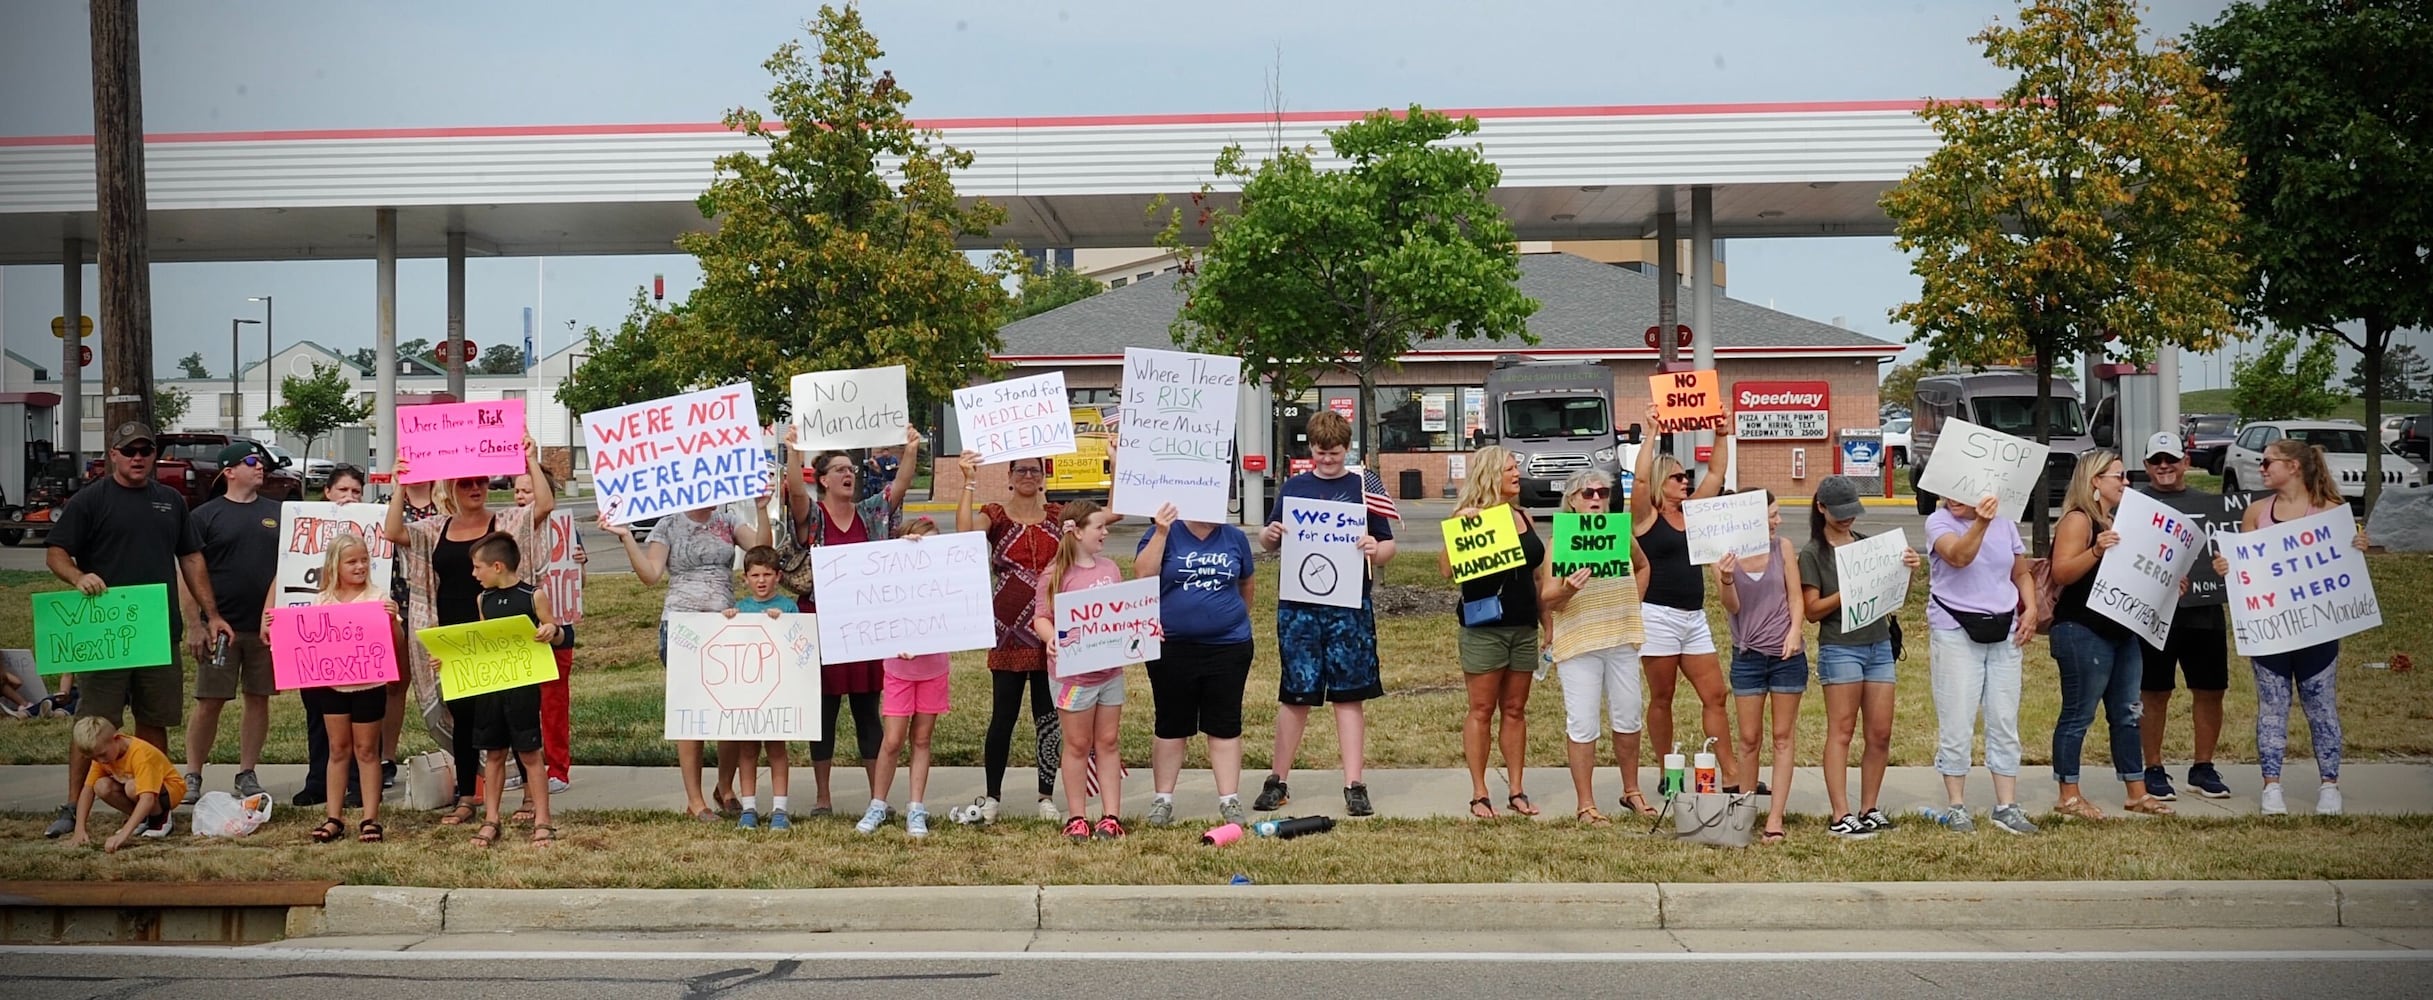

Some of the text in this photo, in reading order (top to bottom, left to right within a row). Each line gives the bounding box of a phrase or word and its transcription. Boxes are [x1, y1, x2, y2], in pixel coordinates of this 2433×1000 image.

[1649, 333, 1656, 342] 8
[1682, 332, 1688, 340] 7
[1132, 357, 1235, 386] Where There
[1674, 374, 1697, 388] NO
[814, 380, 858, 402] NO
[960, 381, 1062, 410] We Stand for
[1130, 386, 1203, 408] Is RISK
[1666, 392, 1706, 407] SHOT
[1740, 391, 1823, 408] Speedway
[401, 416, 437, 434] Where
[593, 394, 740, 444] WE'RE NOT
[803, 403, 904, 440] Mandate
[973, 400, 1058, 430] MEDICAL
[1120, 408, 1170, 431] There
[1173, 416, 1225, 436] Must
[1658, 415, 1726, 432] MANDATE
[1738, 414, 1758, 422] PIZZA
[1763, 414, 1772, 422] AT
[1776, 414, 1790, 422] THE
[1794, 414, 1814, 422] PUMP
[594, 426, 750, 474] ANTI-VAXX
[976, 422, 1069, 453] FREEDOM
[1120, 433, 1232, 464] be CHOICE!
[1962, 432, 2032, 468] STOP
[401, 445, 431, 460] There
[597, 448, 764, 496] WE'RE ANTI-
[1984, 468, 2008, 482] THE
[626, 470, 767, 516] MANDATES
[2224, 493, 2252, 512] MY
[1292, 509, 1330, 524] We
[1461, 515, 1482, 532] NO
[1580, 514, 1607, 530] NO
[1298, 530, 1318, 542] for
[1455, 530, 1496, 552] SHOT
[1570, 535, 1616, 550] SHOT
[2152, 512, 2194, 550] HEROES
[2236, 526, 2331, 561] MY MOM
[821, 545, 978, 588] I STAND FOR
[1452, 546, 1524, 580] MANDATE
[2160, 544, 2174, 562] TO
[2236, 546, 2342, 584] IS STILL
[1552, 560, 1630, 577] MANDATE
[2132, 554, 2173, 587] ZEROS
[856, 578, 962, 606] MEDICAL
[1850, 584, 1864, 599] by
[2246, 574, 2350, 611] MY HERO
[1070, 602, 1103, 622] NO
[1849, 596, 1878, 631] NOT
[297, 613, 364, 643] Who's
[840, 614, 948, 653] FREEDOM
[50, 625, 136, 664] Next?
[790, 634, 808, 655] YES
[295, 642, 386, 683] Next?
[452, 648, 532, 692] Next?
[706, 642, 774, 686] STOP
[676, 707, 802, 736] THE MANDATE!!
